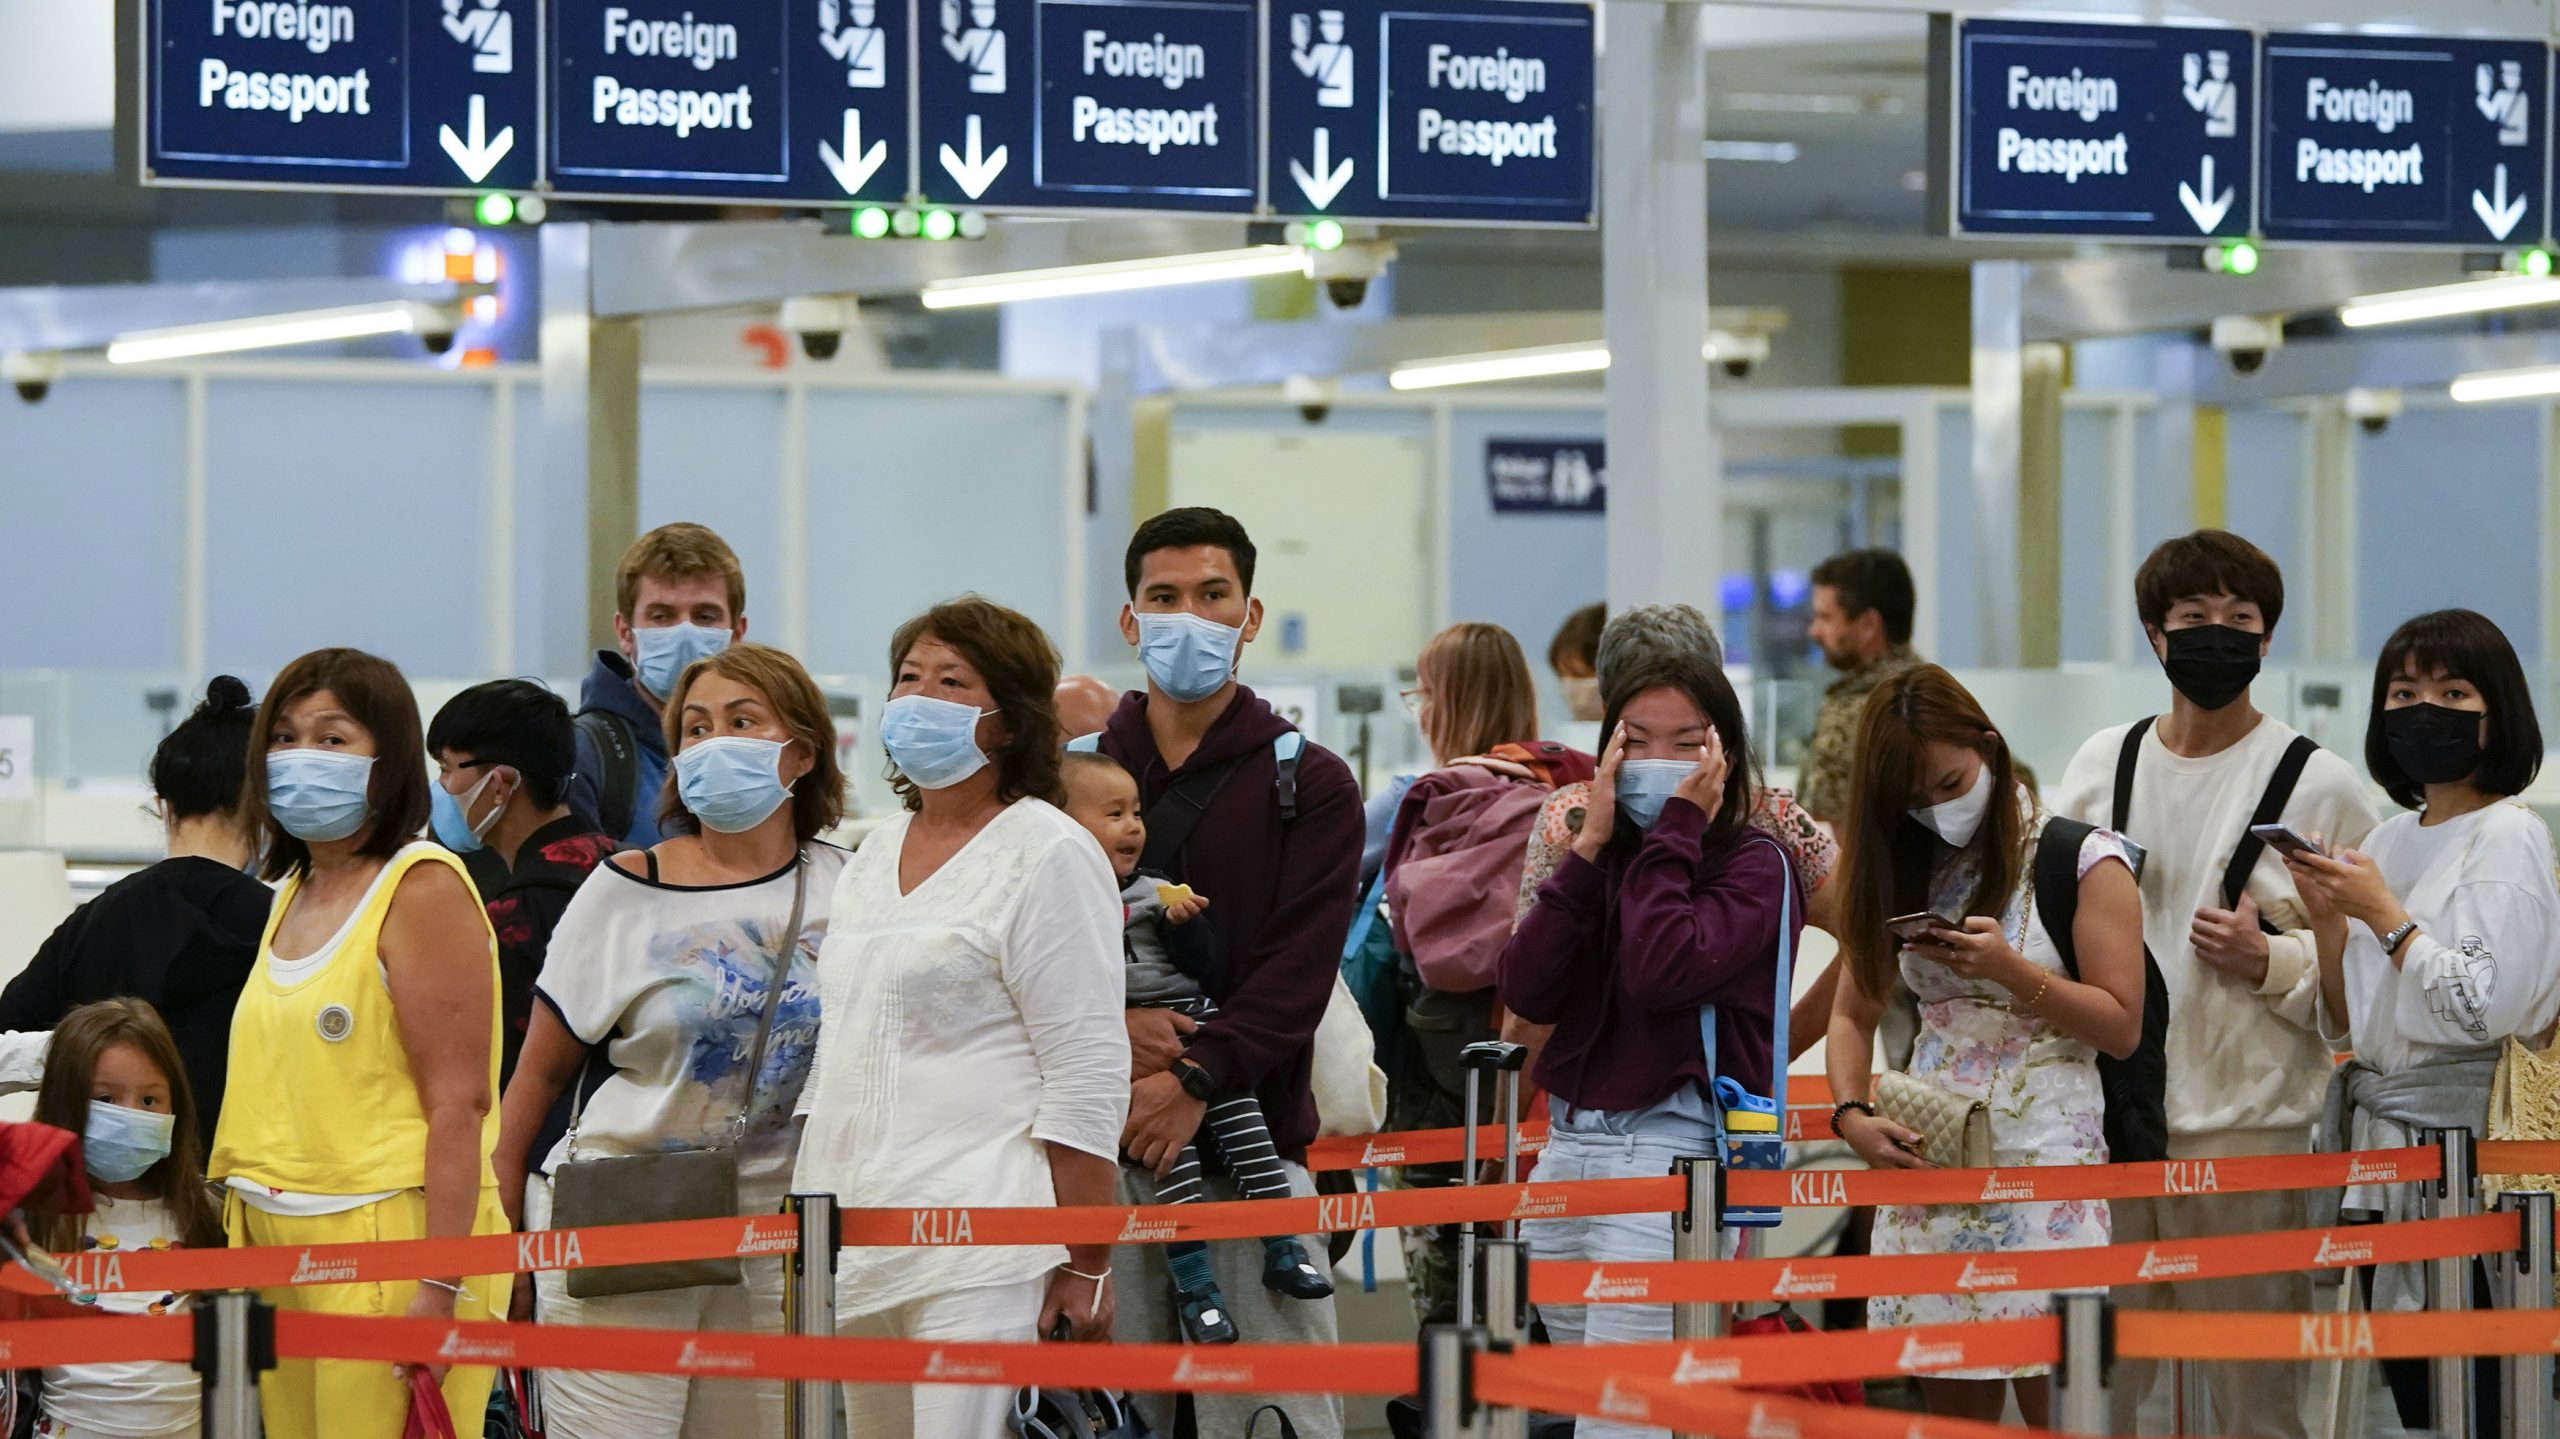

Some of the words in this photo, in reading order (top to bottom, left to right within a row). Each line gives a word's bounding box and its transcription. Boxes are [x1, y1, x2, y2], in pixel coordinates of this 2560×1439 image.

[214, 0, 353, 53] Foreign
[605, 8, 736, 70] Foreign
[1084, 30, 1204, 89] Foreign
[1429, 45, 1545, 102] Foreign
[200, 59, 370, 122] Passport
[594, 76, 752, 138] Passport
[2009, 66, 2117, 121] Foreign
[2308, 78, 2412, 133] Foreign
[1073, 96, 1218, 155] Passport
[1419, 109, 1557, 166] Passport
[1999, 128, 2127, 183] Passport
[2298, 139, 2422, 193] Passport
[1371, 1152, 1406, 1163] AIRPORTS
[2164, 1160, 2218, 1193] KLIA
[2359, 1170, 2397, 1181] AIRPORTS
[1791, 1173, 1847, 1204] KLIA
[1993, 1188, 2034, 1199] AIRPORTS
[911, 1210, 973, 1244] KLIA
[1318, 1195, 1375, 1231] KLIA
[1526, 1203, 1567, 1215] AIRPORTS
[518, 1232, 583, 1269] KLIA
[753, 1238, 798, 1251] AIRPORTS
[1134, 1228, 1177, 1240] AIRPORTS
[307, 1267, 357, 1281] AIRPORTS
[2328, 1248, 2373, 1262] AIRPORTS
[2302, 1314, 2375, 1356] KLIA
